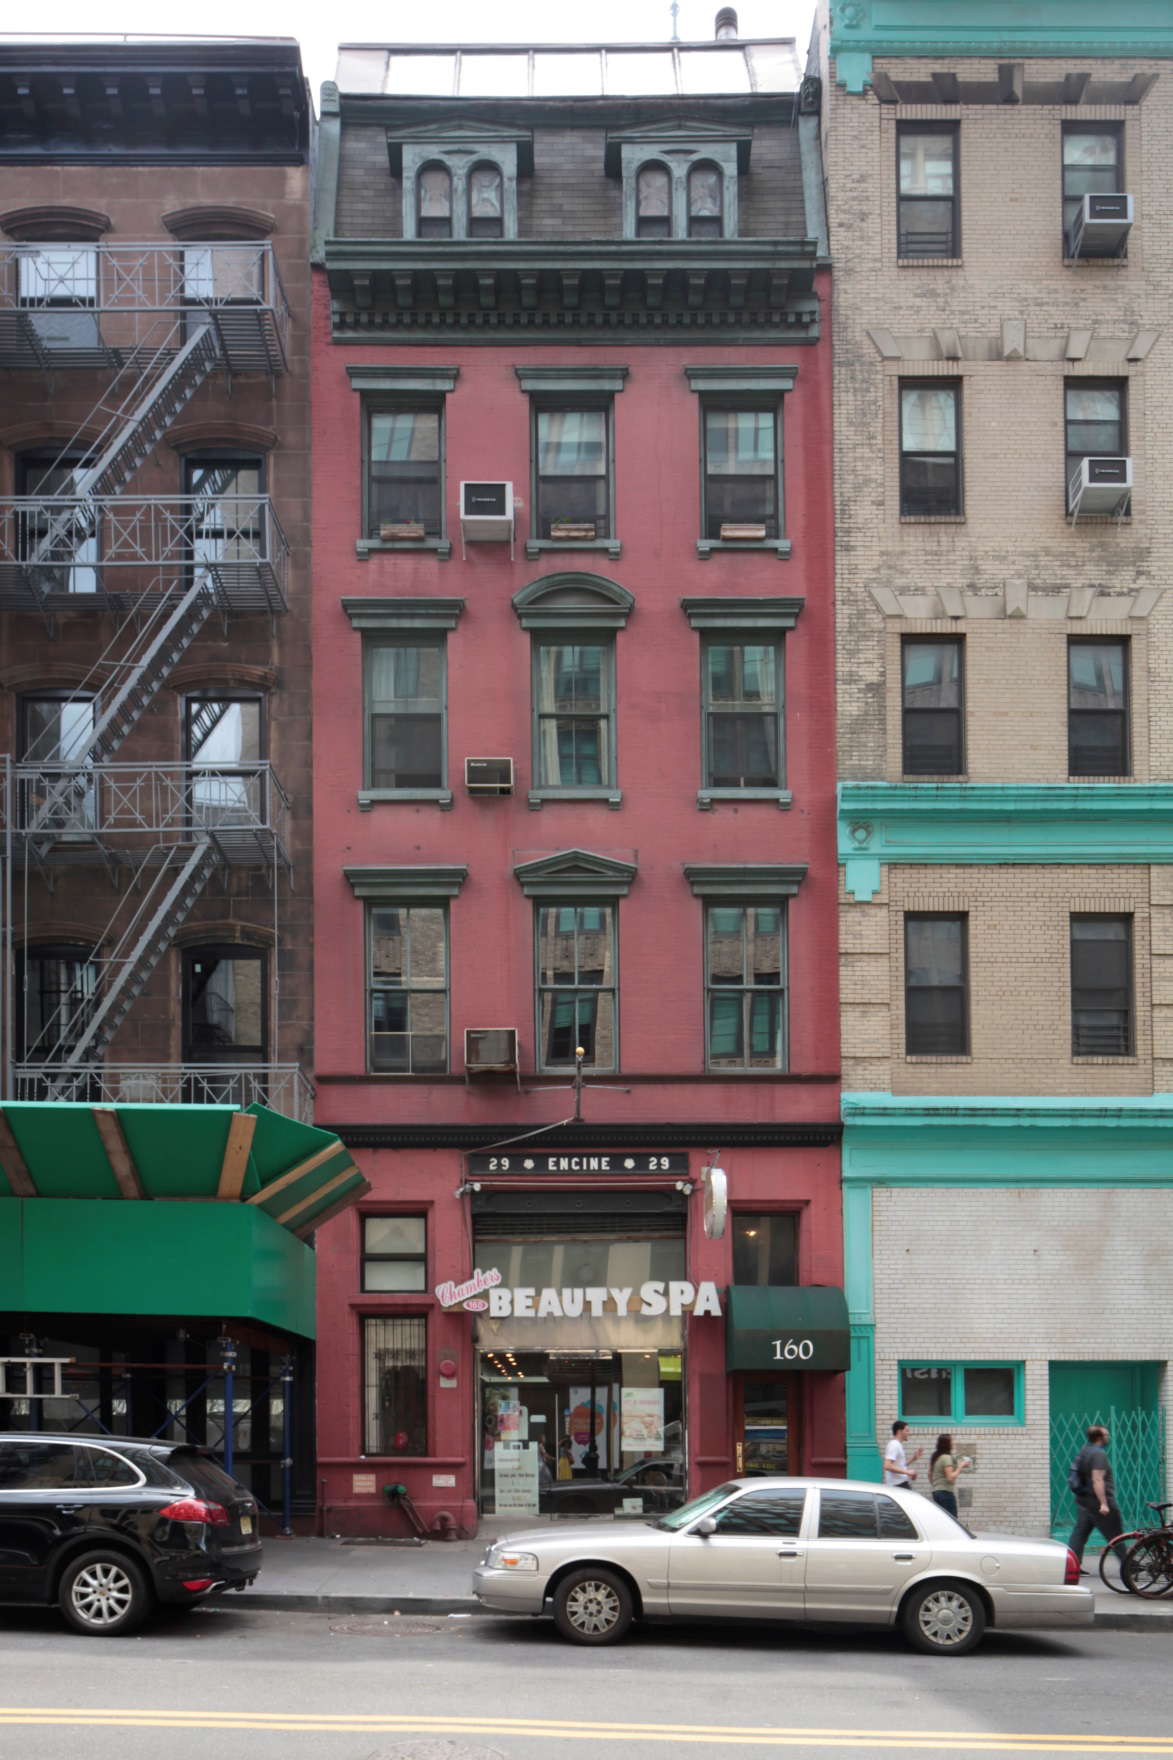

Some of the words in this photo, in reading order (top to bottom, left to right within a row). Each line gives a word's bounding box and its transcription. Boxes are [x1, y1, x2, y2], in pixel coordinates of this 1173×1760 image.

[489, 1157, 510, 1171] 29
[648, 1157, 670, 1171] 29
[436, 1269, 501, 1306] Chambers
[468, 1301, 483, 1309] 160
[489, 1287, 633, 1318] BEAUTY
[639, 1280, 722, 1317] SPA
[771, 1338, 814, 1360] 160
